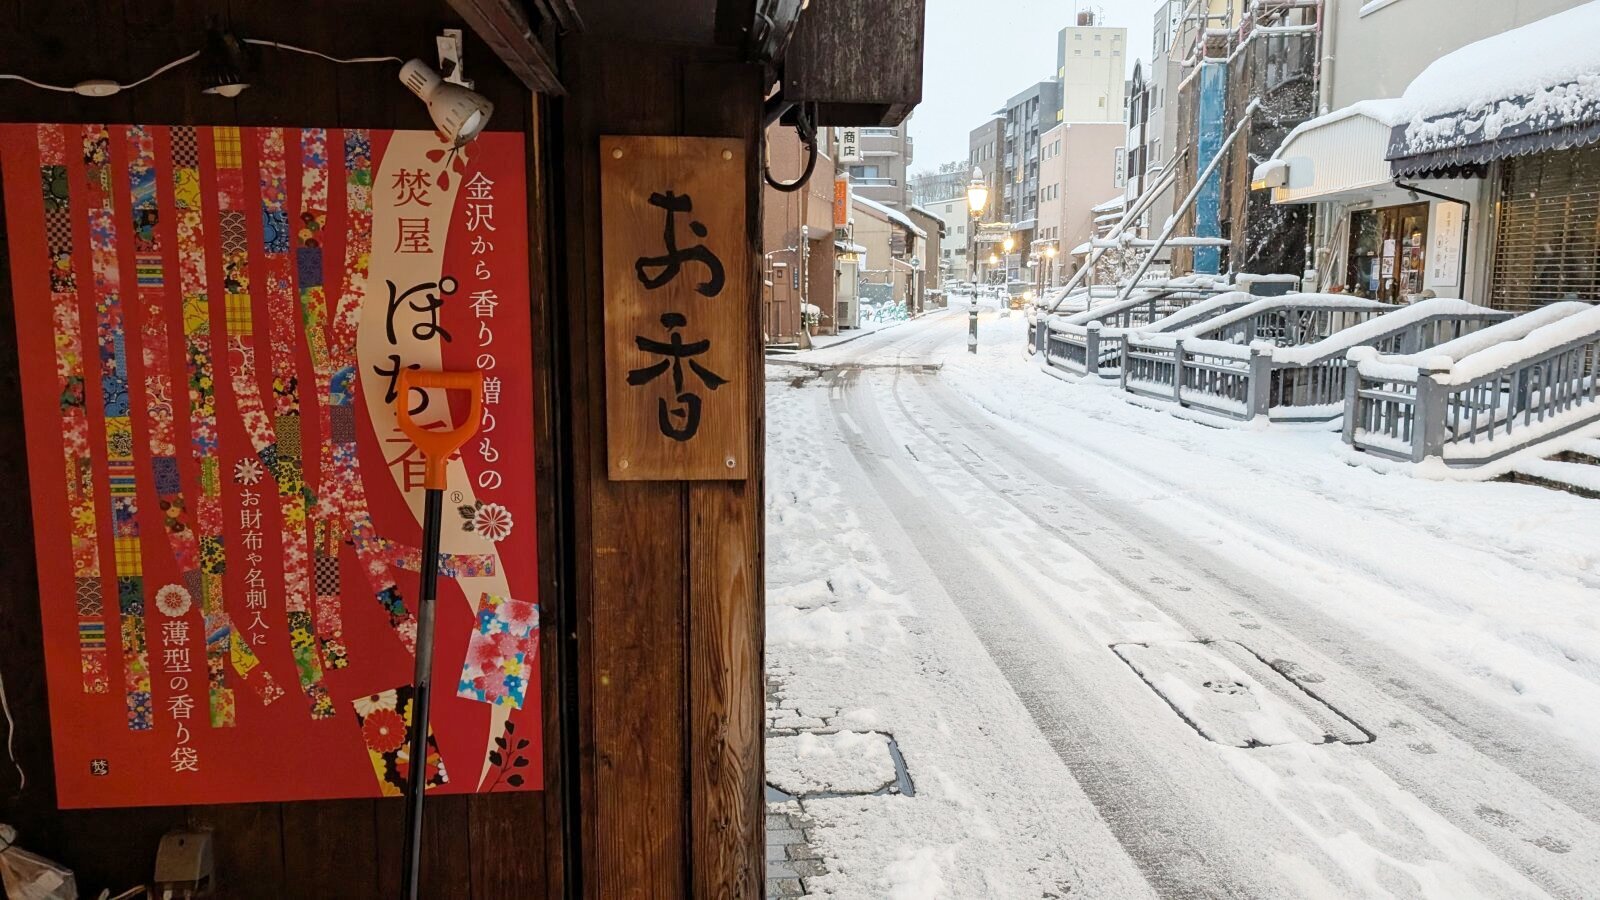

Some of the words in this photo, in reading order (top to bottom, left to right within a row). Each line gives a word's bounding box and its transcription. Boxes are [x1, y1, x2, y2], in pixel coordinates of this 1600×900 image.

[843, 127, 856, 157] 商店
[626, 190, 731, 442] お香
[240, 488, 270, 646] お財布や名刺入に
[161, 621, 200, 773] 薄型の香り袋
